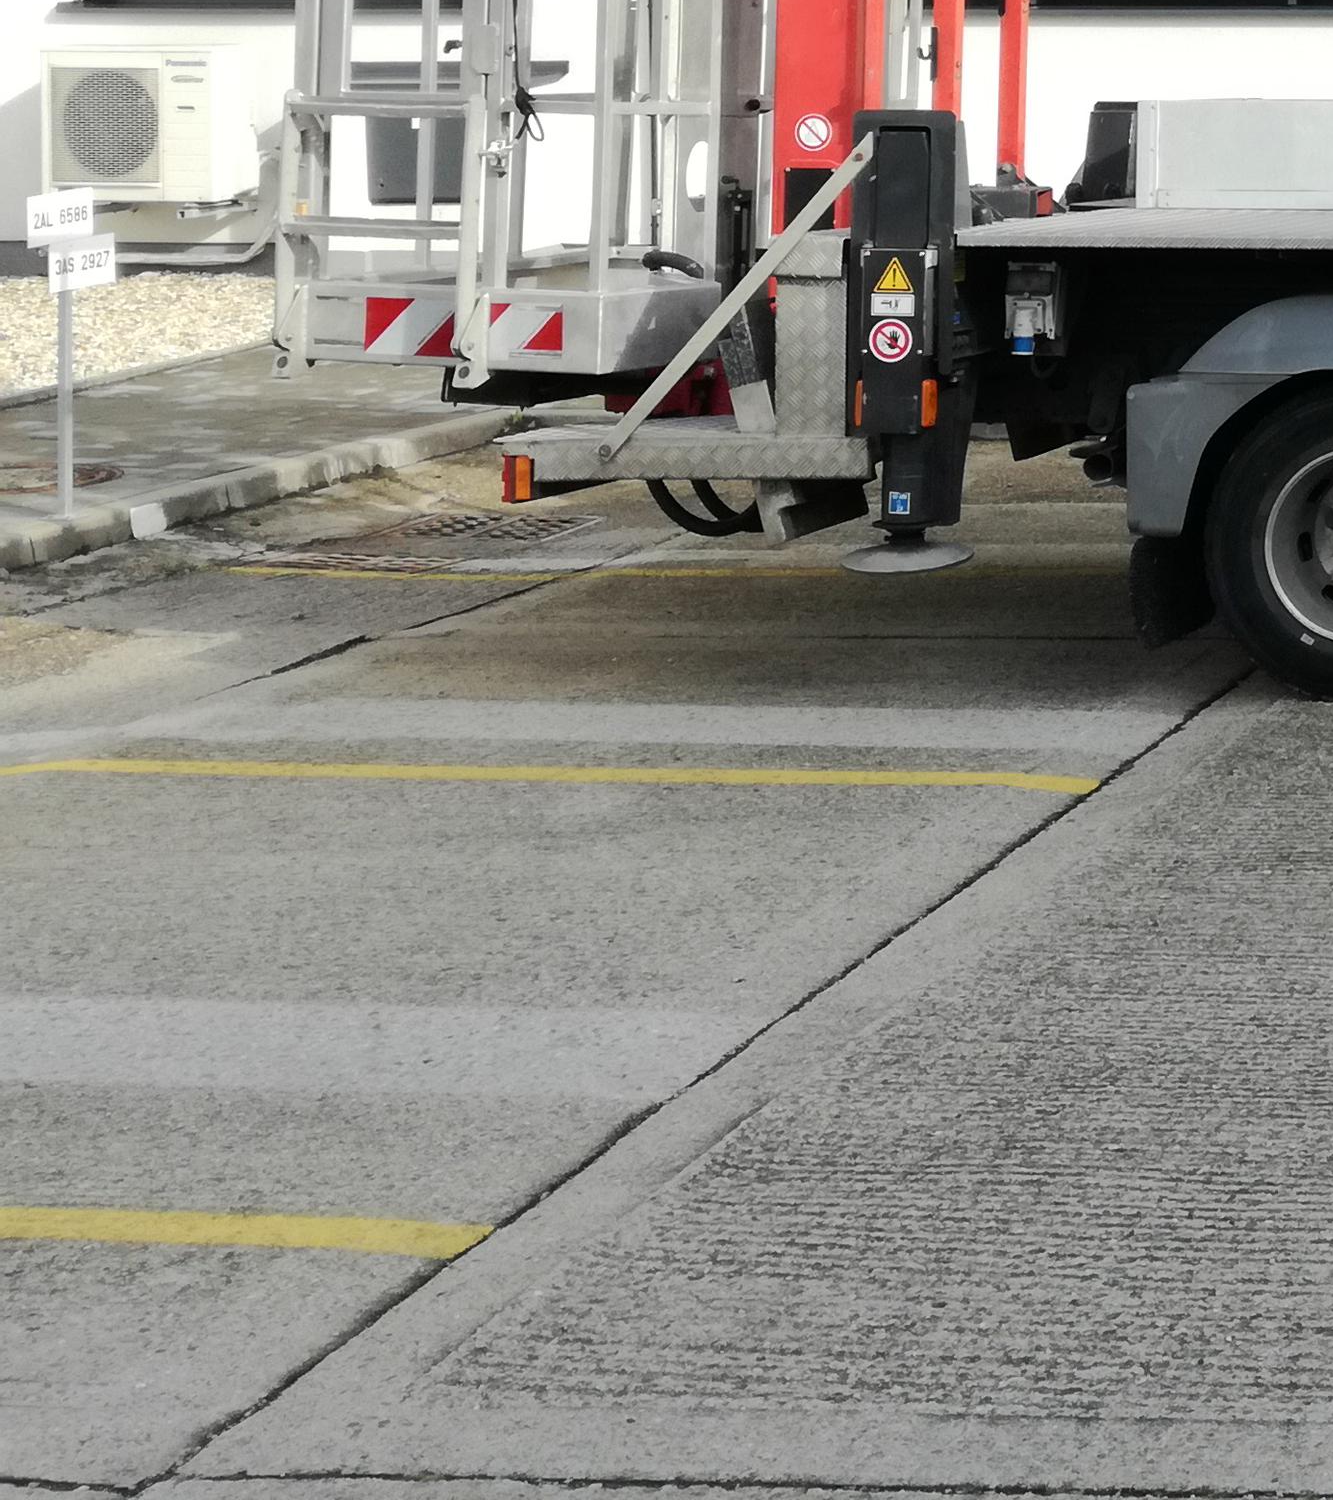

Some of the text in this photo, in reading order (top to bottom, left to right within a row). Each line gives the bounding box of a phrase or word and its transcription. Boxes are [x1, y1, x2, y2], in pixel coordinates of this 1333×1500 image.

[33, 206, 88, 230] 2AL 6586
[55, 250, 111, 276] 3AS 2927
